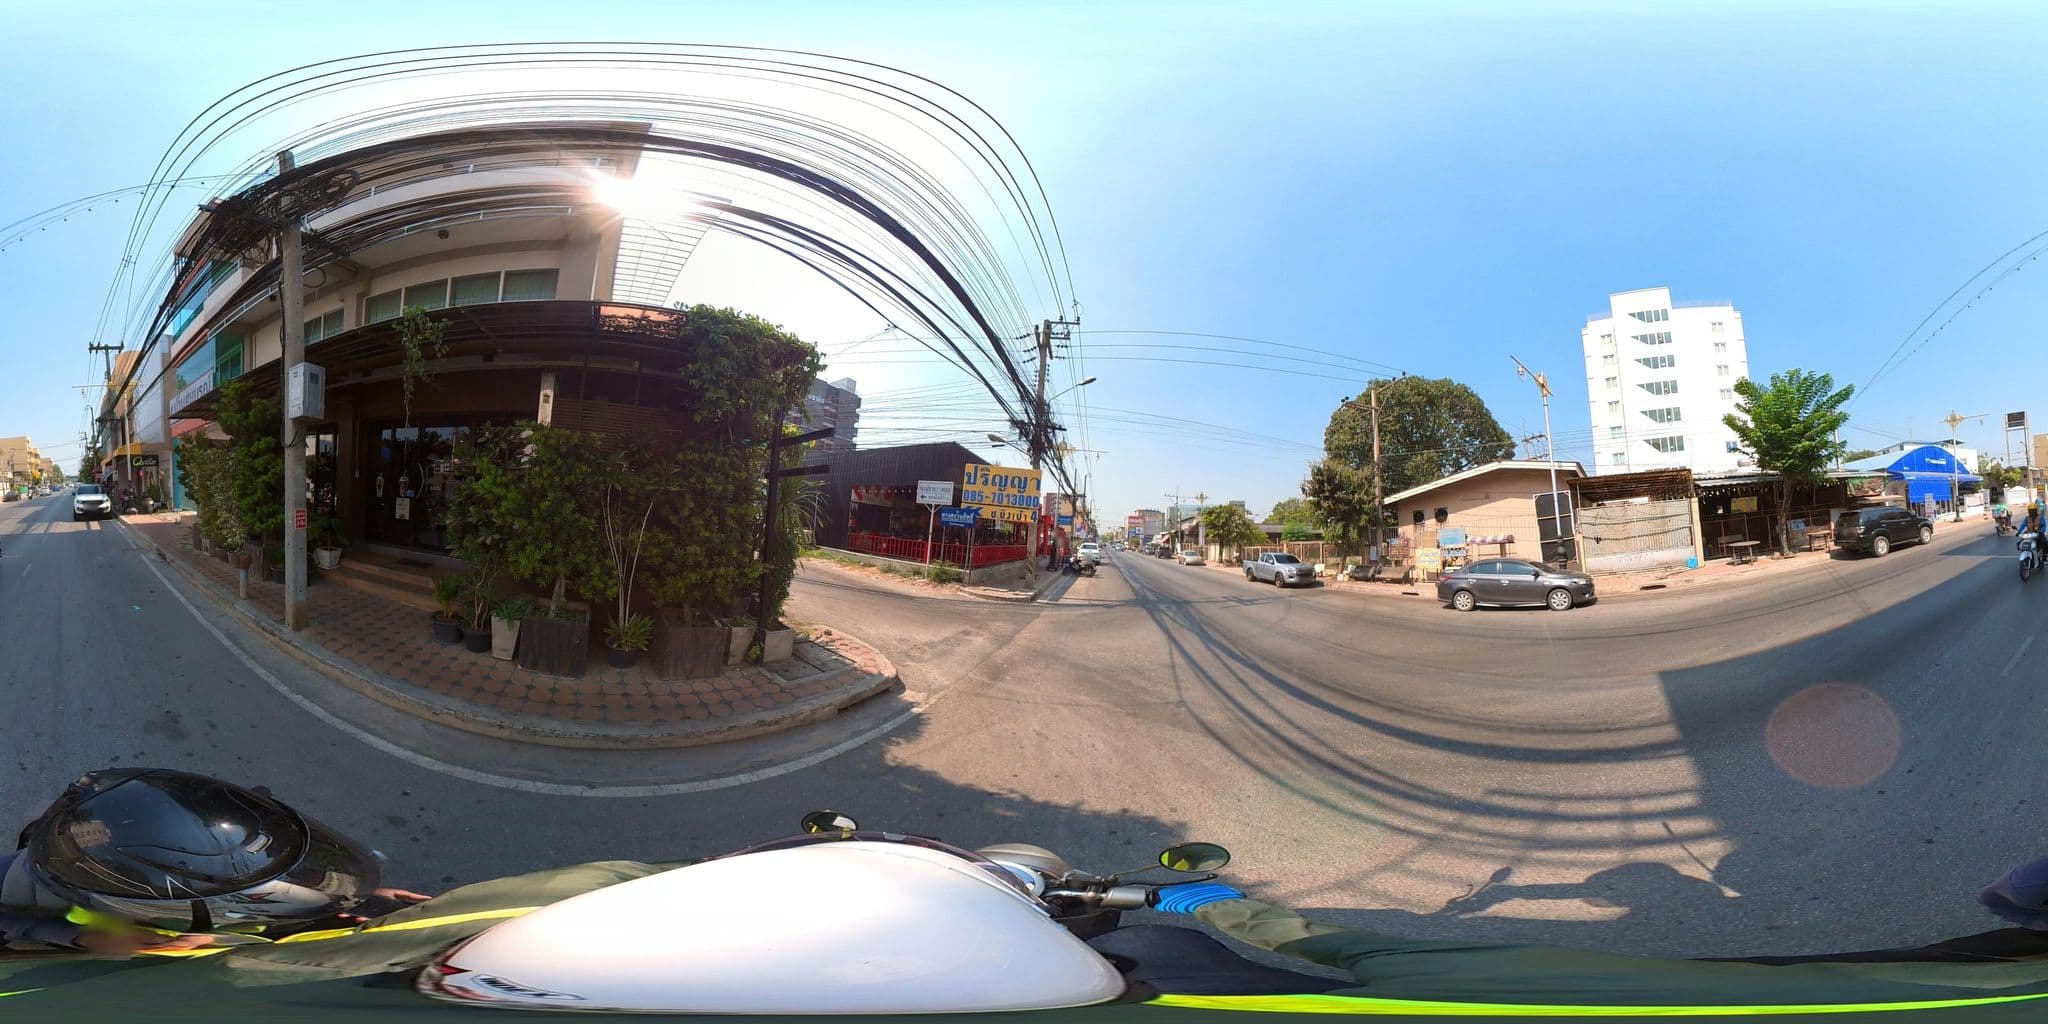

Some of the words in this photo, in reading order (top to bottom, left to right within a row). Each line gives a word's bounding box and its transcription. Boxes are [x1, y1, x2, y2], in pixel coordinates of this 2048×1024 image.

[966, 464, 1040, 493] ปริญญา
[963, 490, 1040, 508] 085-7013000
[1030, 511, 1037, 523] 4
